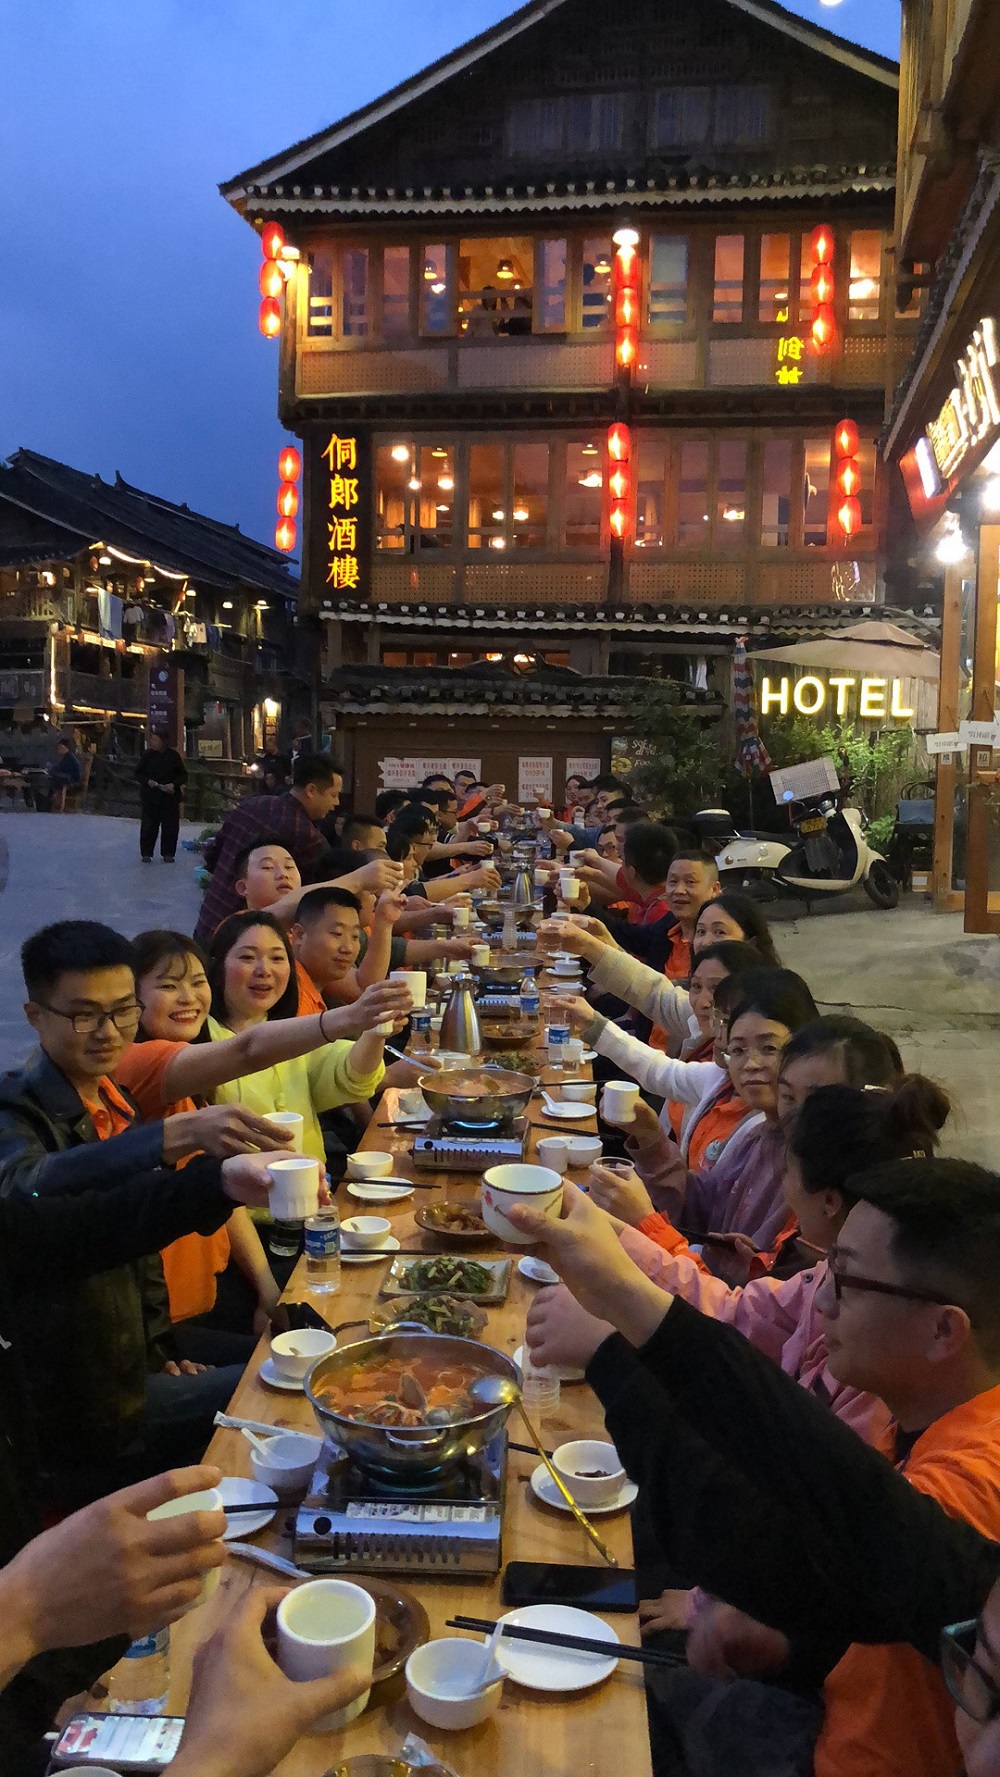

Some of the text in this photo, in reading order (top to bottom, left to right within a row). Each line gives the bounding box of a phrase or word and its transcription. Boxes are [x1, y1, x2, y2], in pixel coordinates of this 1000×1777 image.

[320, 433, 361, 589] 侗郎酒樓
[761, 676, 914, 717] HOTEL
